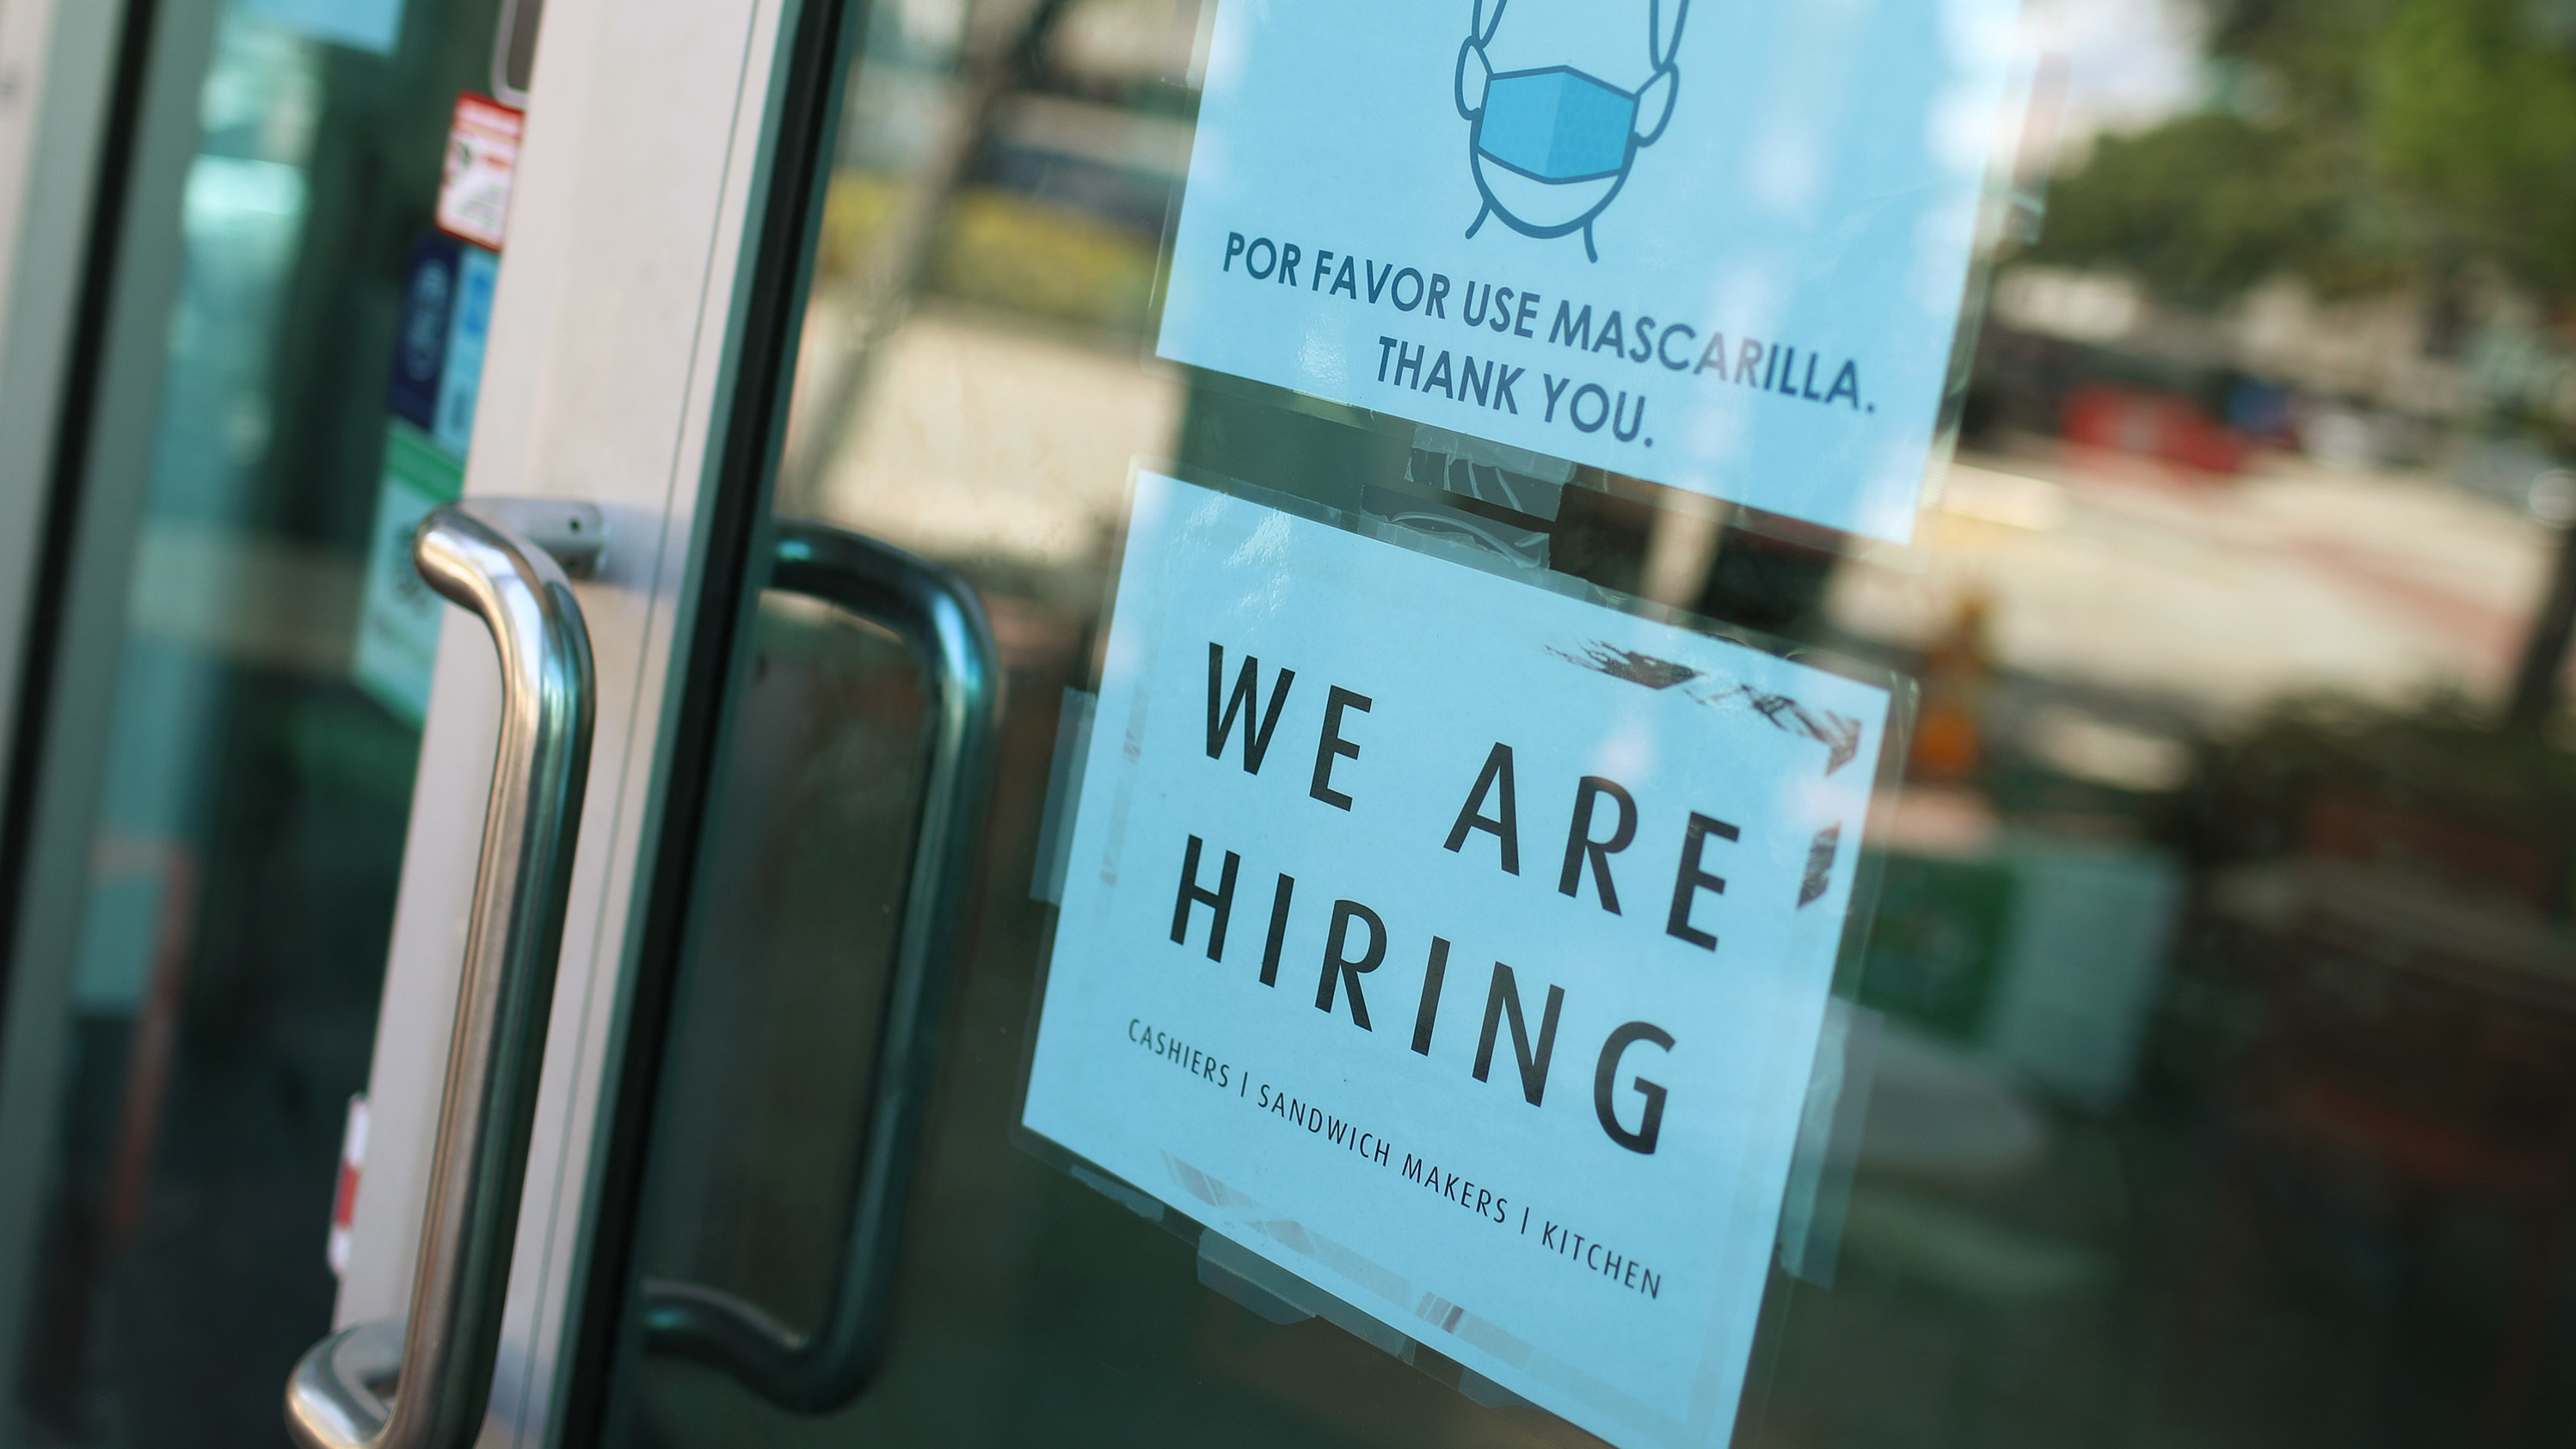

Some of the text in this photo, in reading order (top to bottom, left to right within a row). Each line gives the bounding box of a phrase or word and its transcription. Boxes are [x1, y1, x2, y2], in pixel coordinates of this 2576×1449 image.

[1222, 230, 1876, 414] POR FAVOR USE MASCARILLA.
[1377, 335, 1654, 448] THANK YOU.
[1206, 642, 1741, 953] WE ARE
[1169, 833, 1676, 1157] HIRING
[1128, 1018, 1230, 1088] CASHIERS
[1257, 1084, 1391, 1168] SANDWICH
[1401, 1152, 1508, 1224] MAKERS
[1541, 1220, 1662, 1300] KITCHEN
